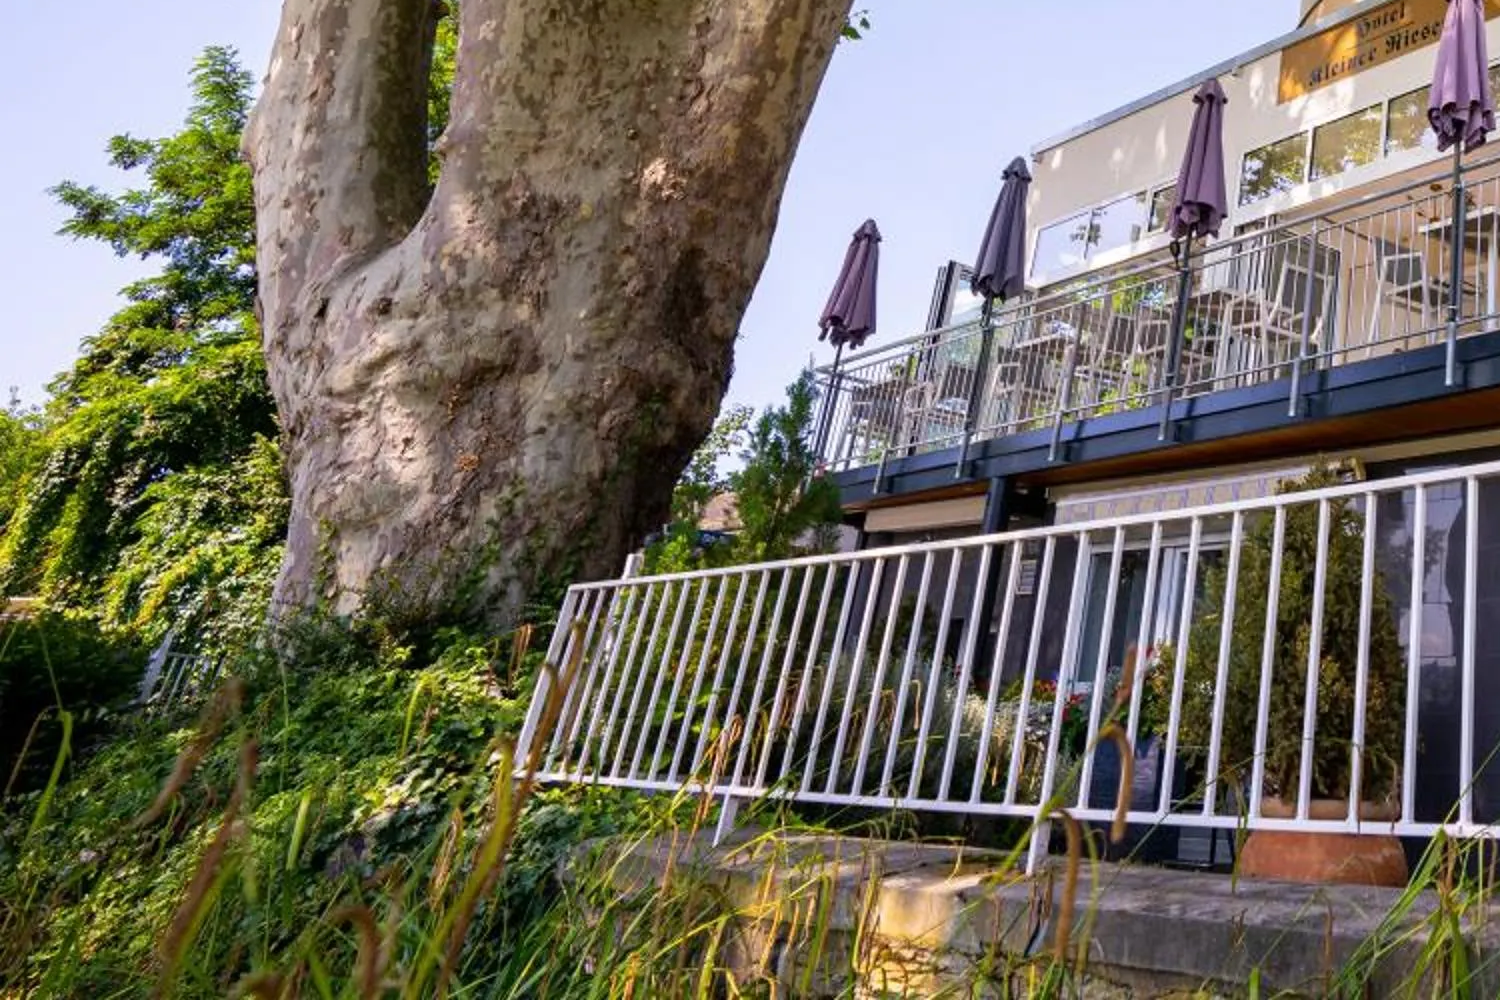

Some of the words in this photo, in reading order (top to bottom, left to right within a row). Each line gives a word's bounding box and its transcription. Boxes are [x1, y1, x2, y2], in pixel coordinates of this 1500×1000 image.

[1358, 3, 1406, 37] Hotel
[1309, 47, 1378, 87] Kleiner
[1385, 18, 1446, 55] Riese
